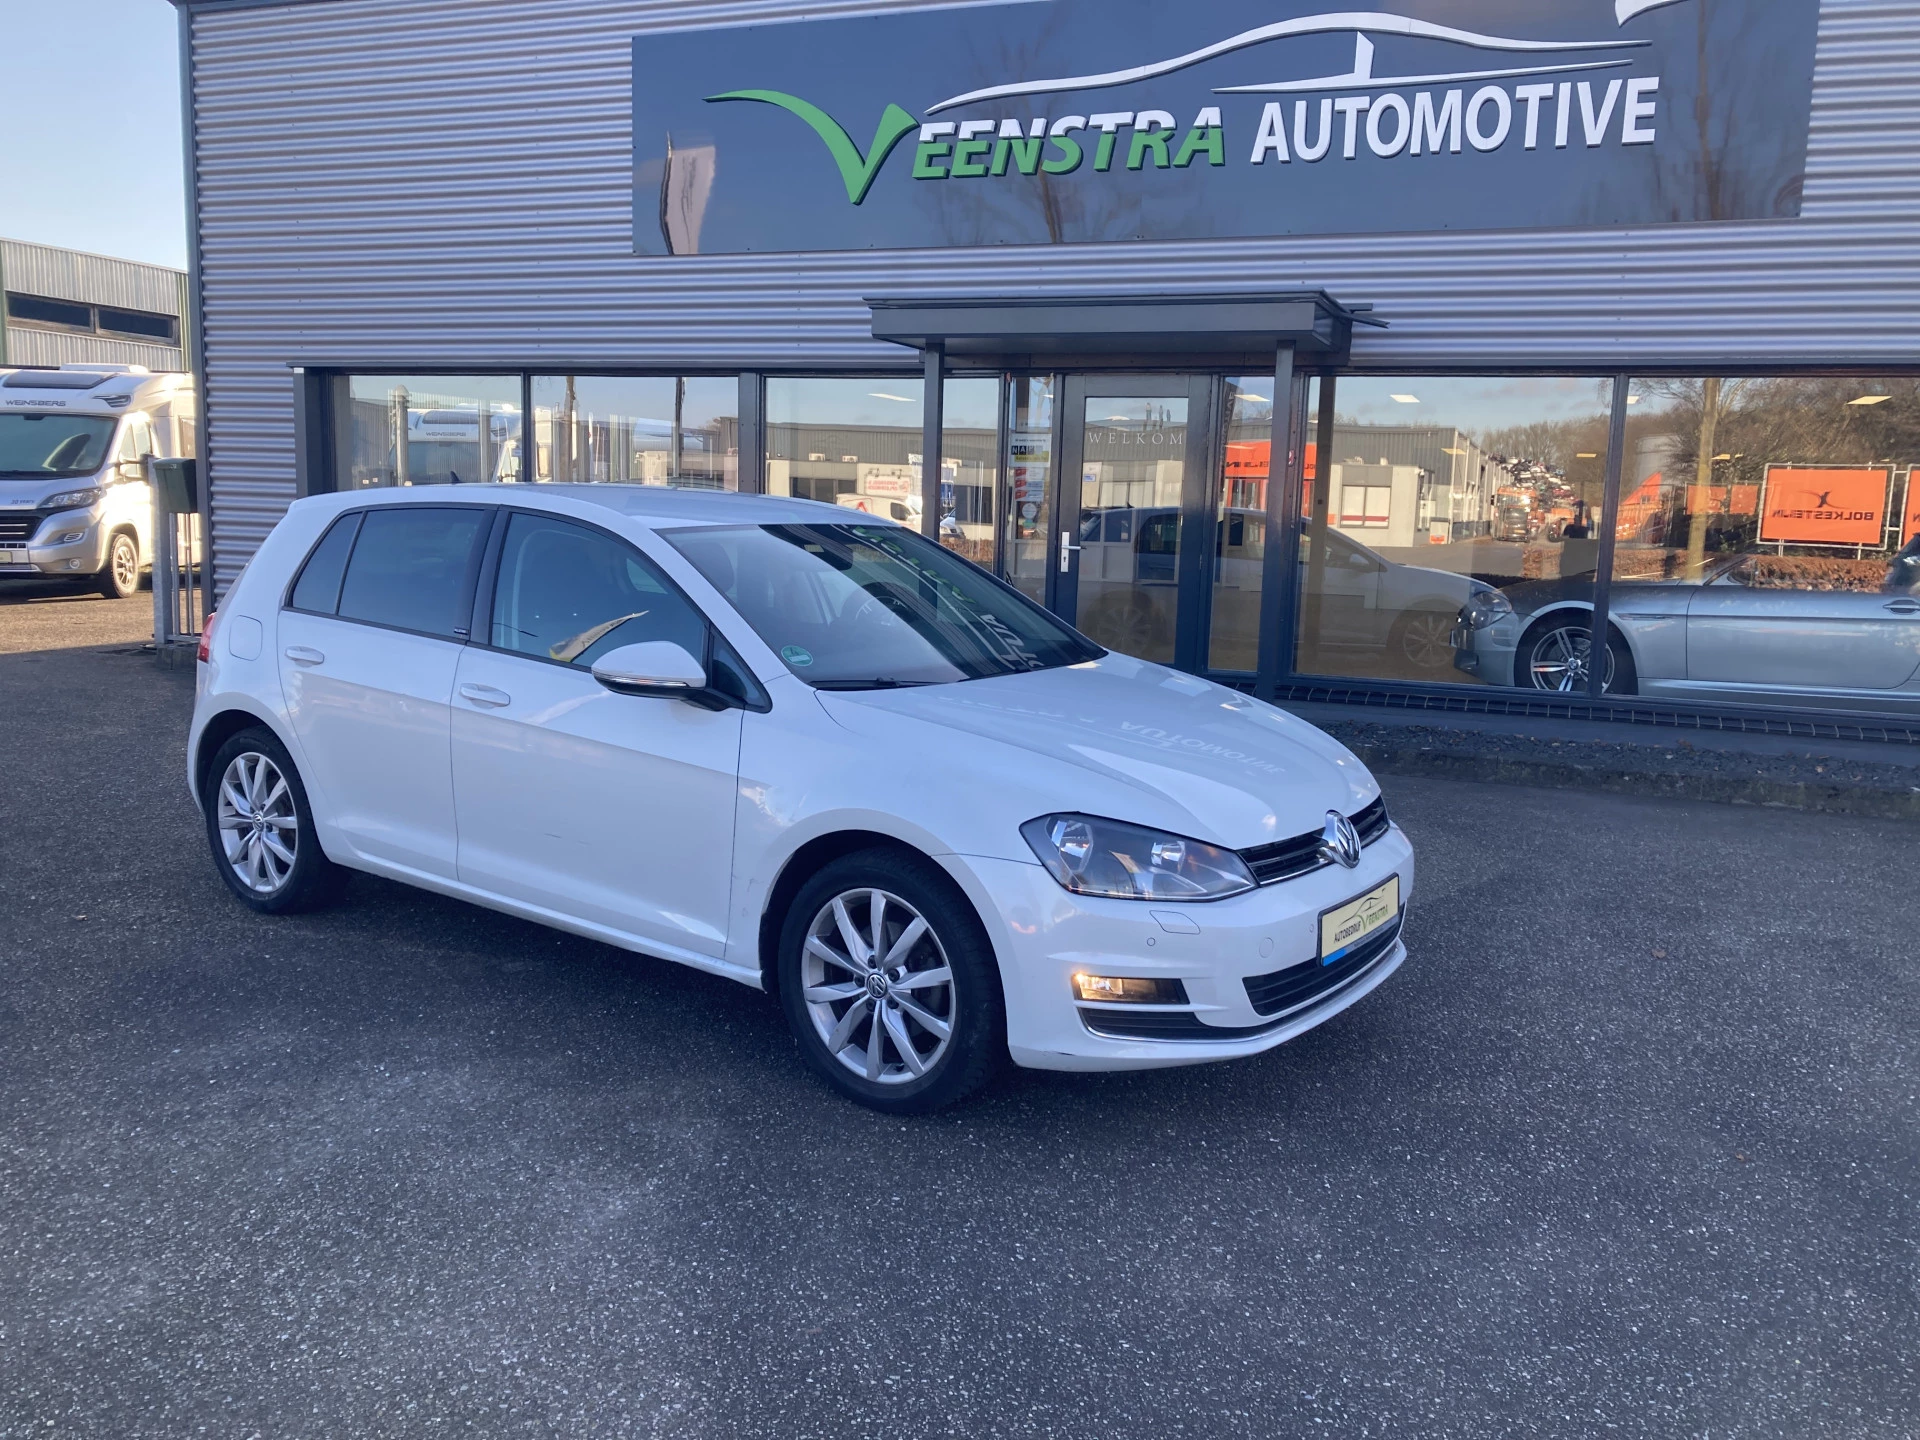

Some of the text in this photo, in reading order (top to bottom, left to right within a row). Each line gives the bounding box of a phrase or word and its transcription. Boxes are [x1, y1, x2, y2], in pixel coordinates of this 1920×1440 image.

[702, 76, 1660, 206] VEENSTRA AUTOMOTIVE
[1088, 432, 1182, 445] WELKOM
